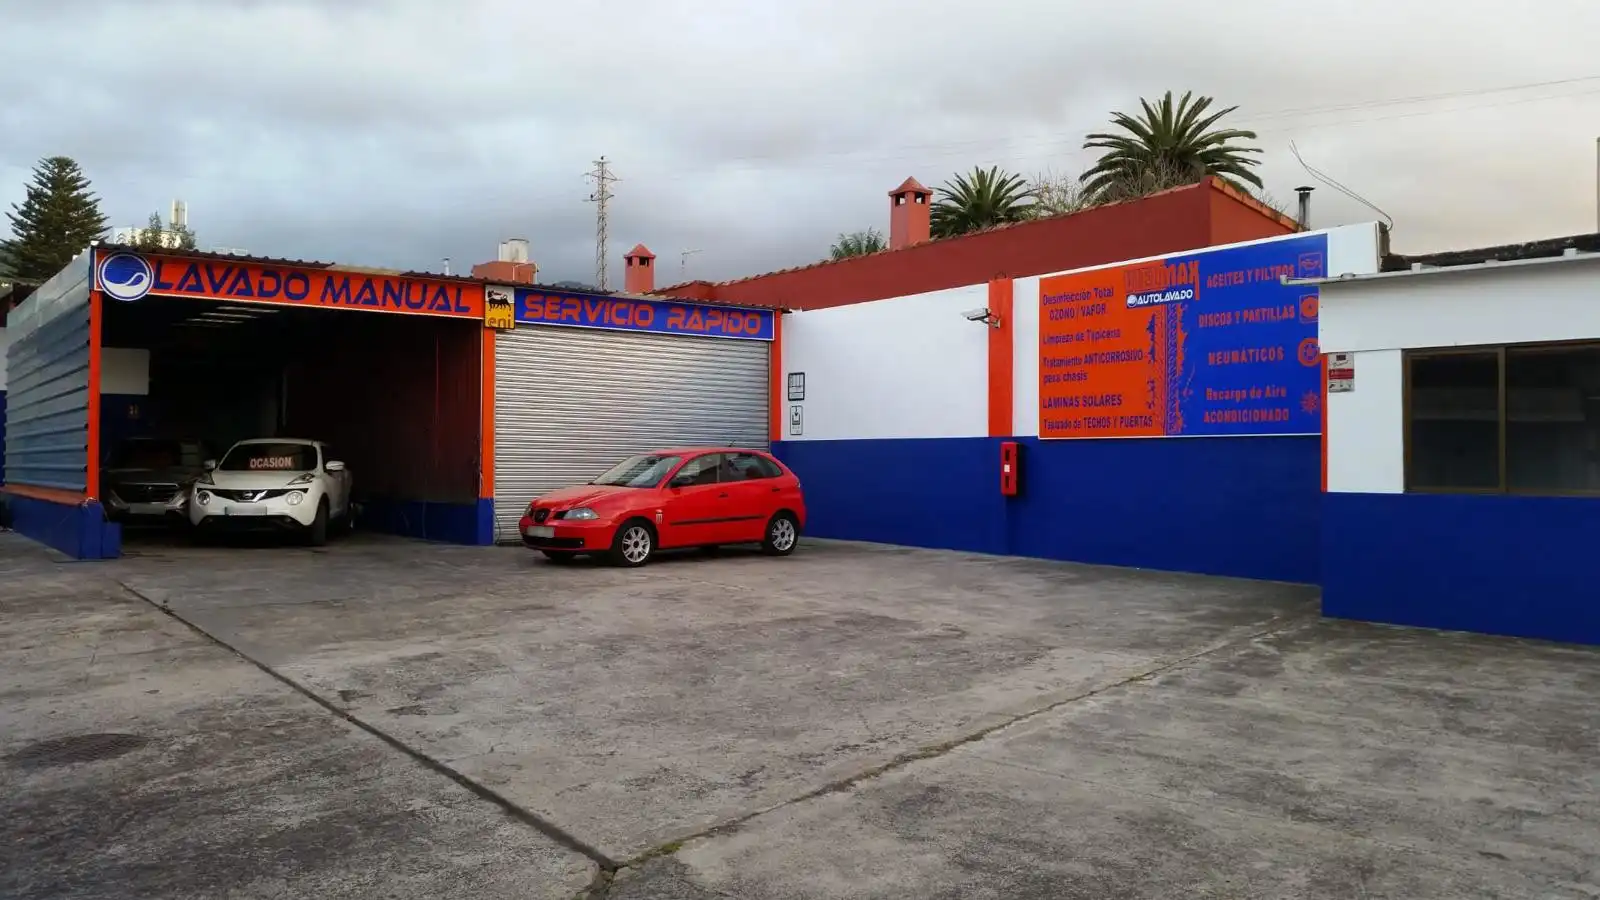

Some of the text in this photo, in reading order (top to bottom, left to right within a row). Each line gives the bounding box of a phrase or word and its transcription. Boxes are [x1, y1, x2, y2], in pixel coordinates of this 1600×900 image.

[1207, 264, 1295, 288] ACEITES Y FILTROS
[154, 259, 471, 313] LAVADO MANUAL
[1093, 287, 1114, 299] Total
[1137, 289, 1193, 305] AUTOLAVADO
[524, 294, 762, 334] SERVICIO RAPIDO
[1049, 307, 1075, 321] OZONO
[1081, 303, 1106, 317] VAPOR
[1199, 312, 1232, 328] DISCOS
[1243, 305, 1295, 323] PASTILLAS
[487, 313, 512, 328] eni
[1075, 331, 1085, 342] de
[1043, 349, 1143, 368] Tratamiento ANTICORROSIVO
[1082, 394, 1122, 408] SOLARES
[1206, 384, 1288, 403] Recarga de Aire
[1073, 418, 1081, 429] de
[1083, 417, 1111, 429] TECHOS
[1119, 415, 1153, 429] PUERTAS
[1203, 408, 1290, 423] ACONDICIONADO
[249, 457, 292, 468] OCASION
